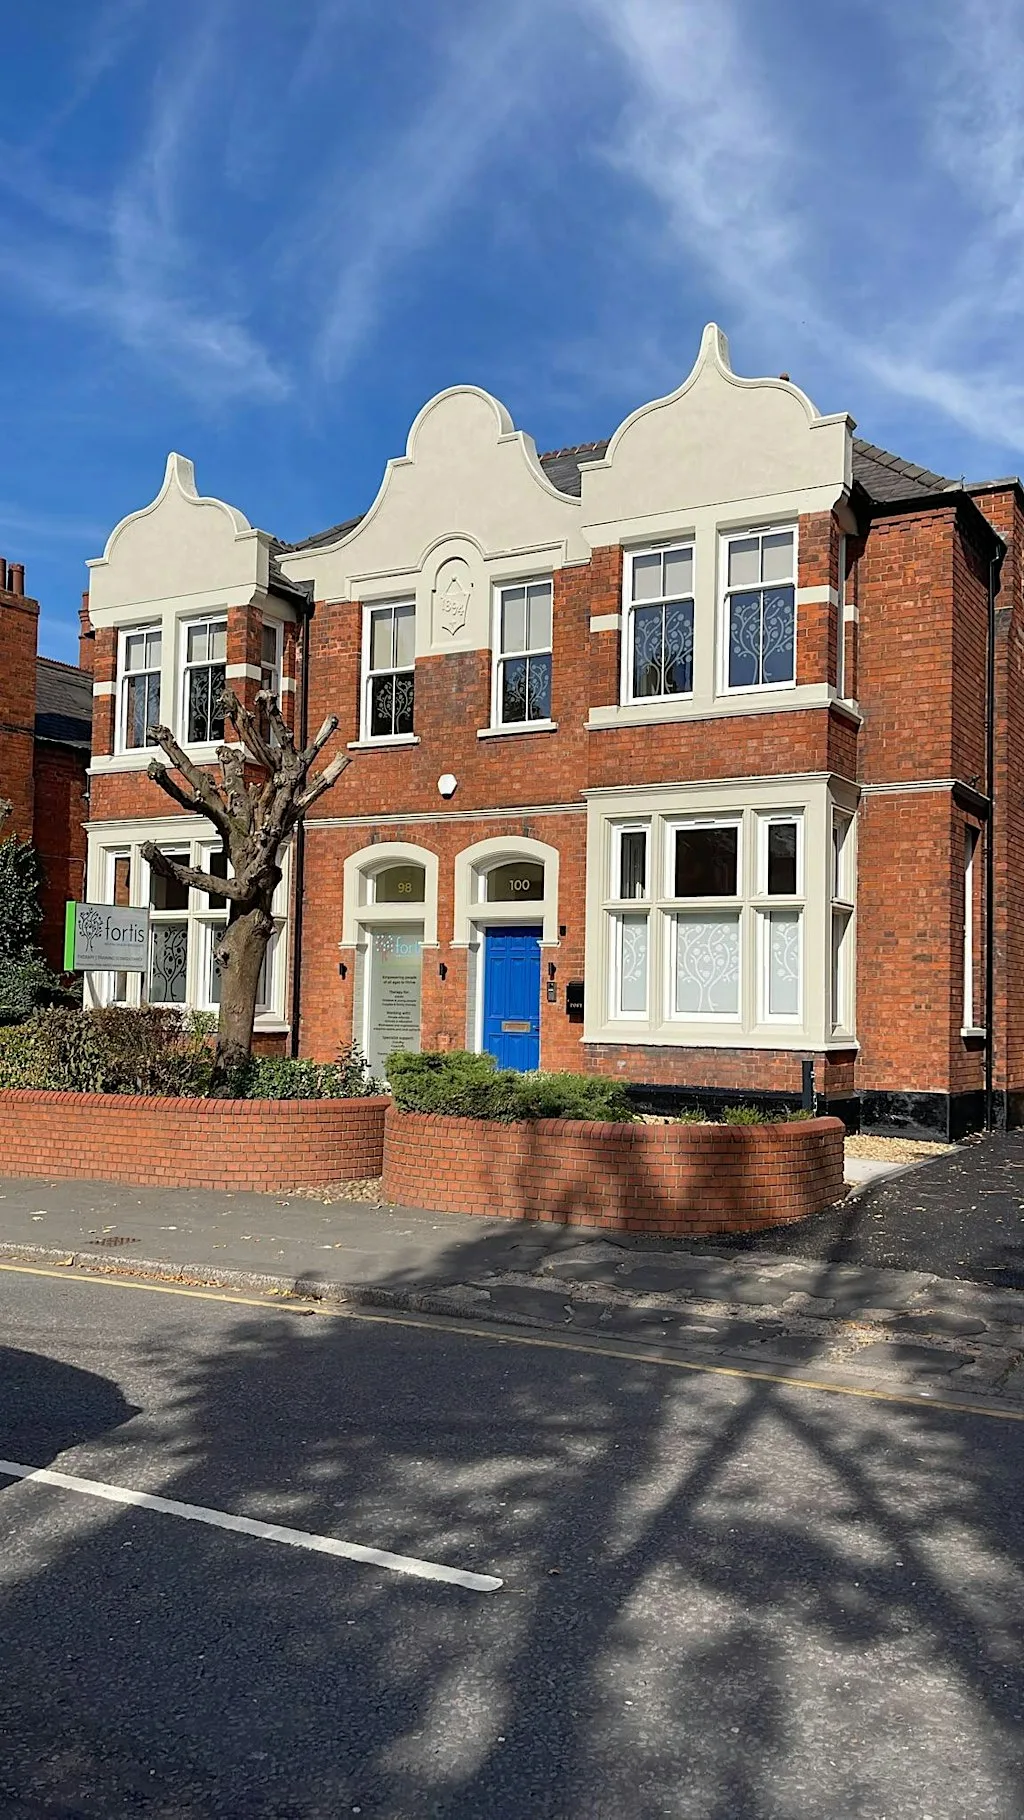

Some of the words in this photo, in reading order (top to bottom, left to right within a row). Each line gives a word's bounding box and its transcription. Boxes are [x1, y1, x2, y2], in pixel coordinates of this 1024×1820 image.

[397, 882, 412, 893] 98
[509, 879, 531, 891] 100
[105, 916, 145, 943] fortis
